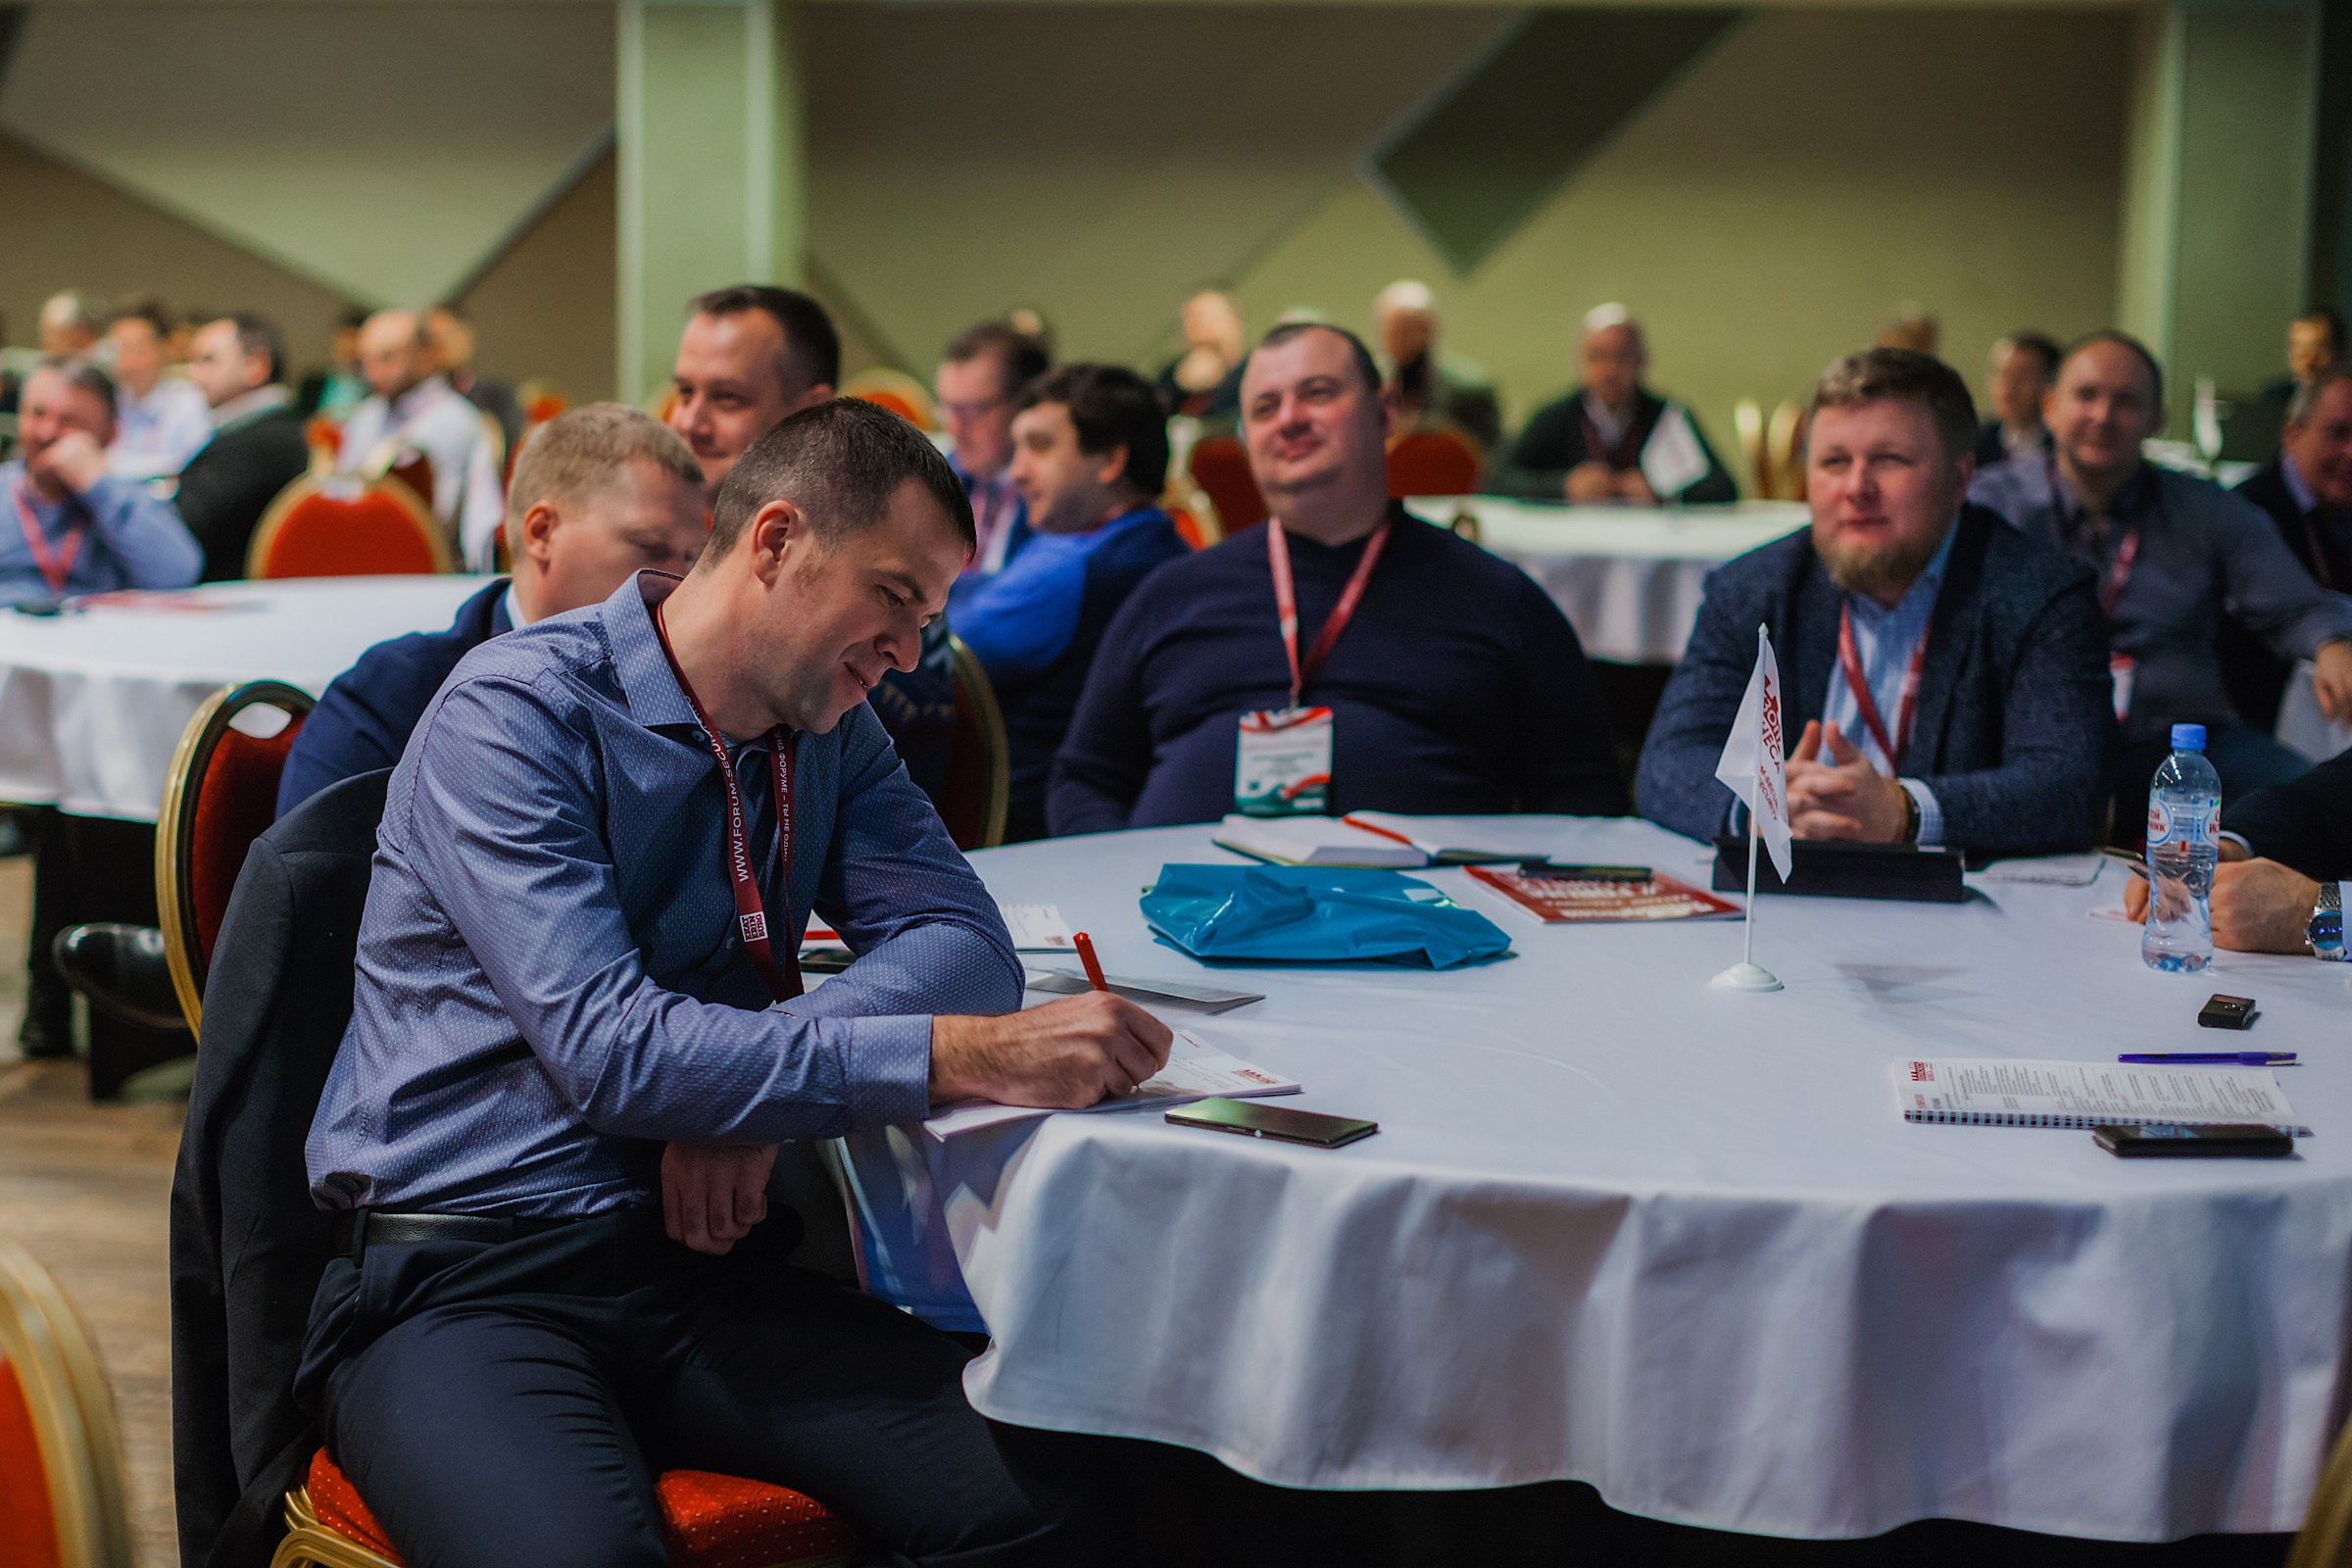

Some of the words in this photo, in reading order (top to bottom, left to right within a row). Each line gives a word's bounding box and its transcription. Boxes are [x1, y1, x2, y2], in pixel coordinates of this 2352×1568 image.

[776, 738, 785, 752] НА
[778, 753, 788, 794] ФОРУМЕ
[782, 803, 790, 817] ТЫ
[784, 819, 790, 832] НЕ
